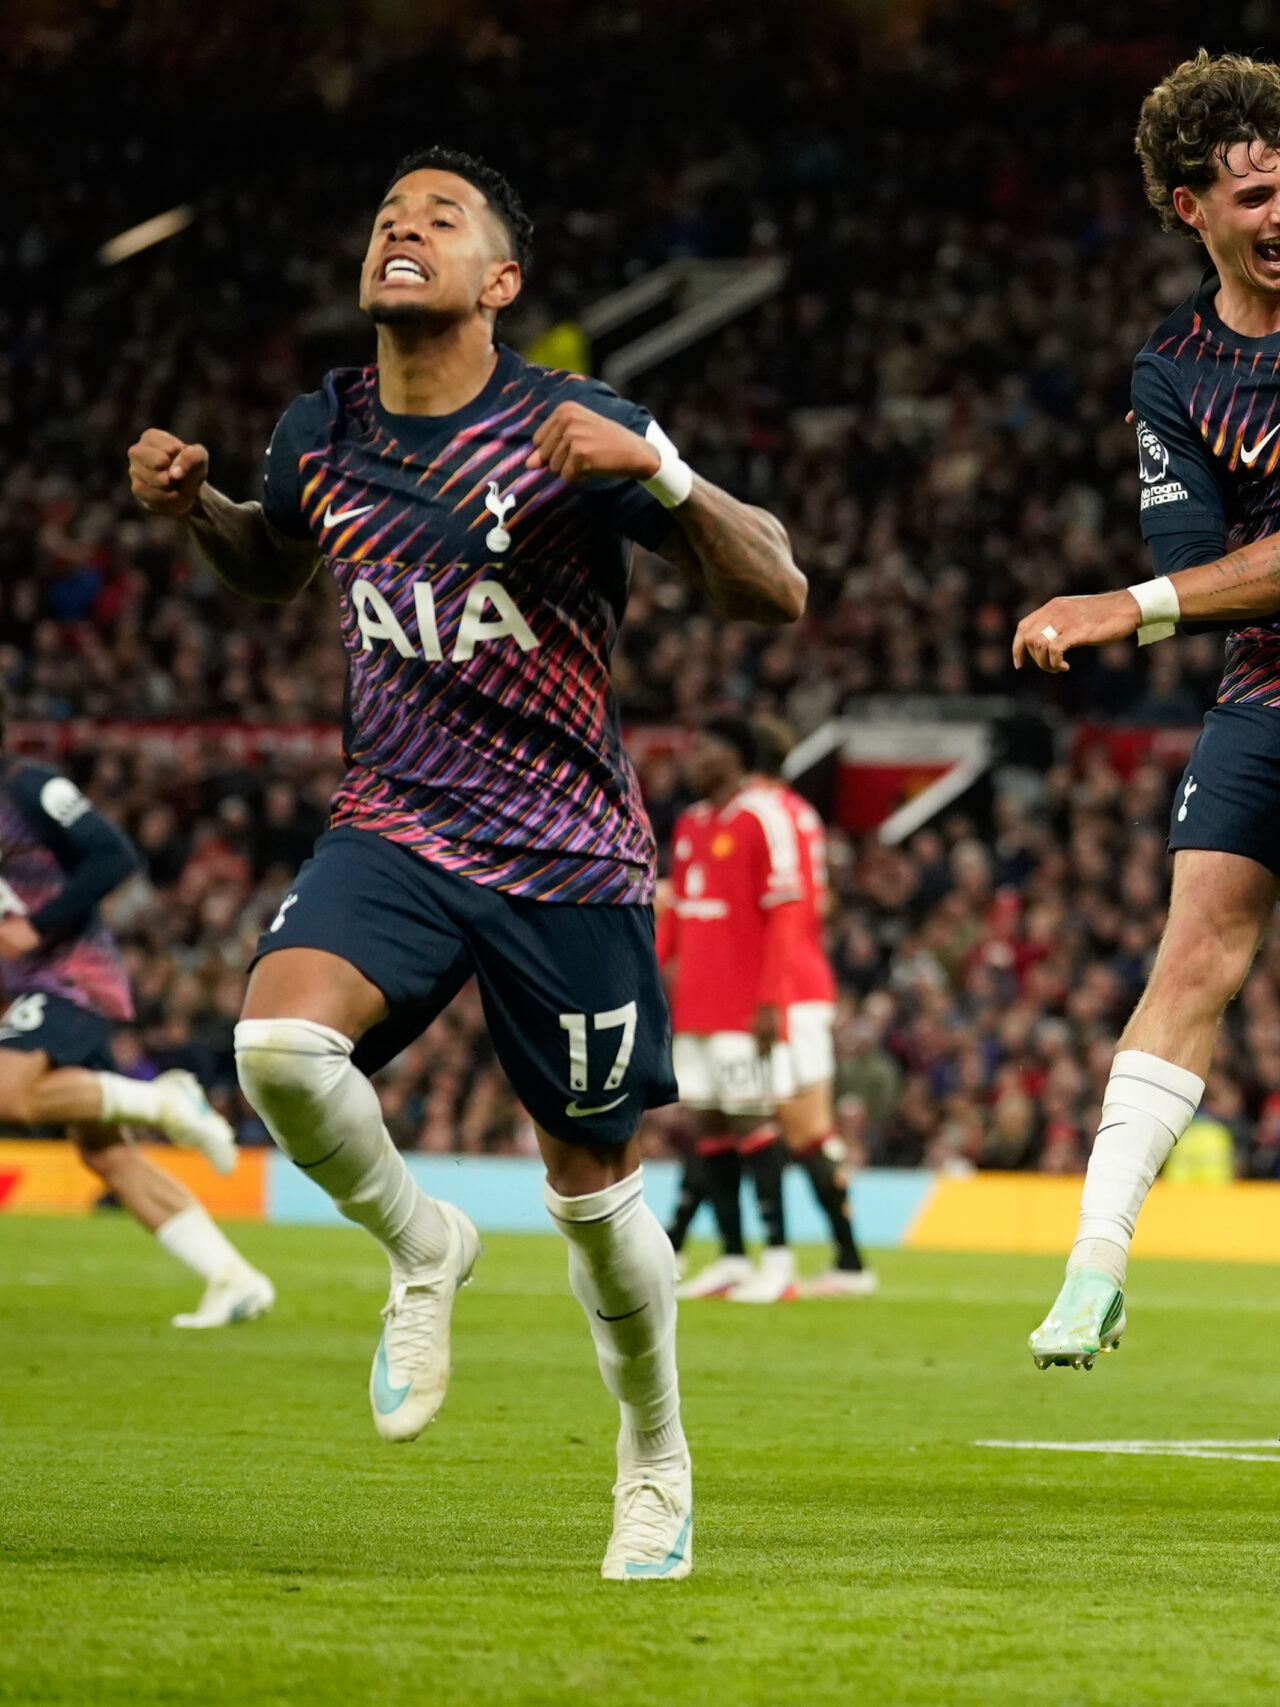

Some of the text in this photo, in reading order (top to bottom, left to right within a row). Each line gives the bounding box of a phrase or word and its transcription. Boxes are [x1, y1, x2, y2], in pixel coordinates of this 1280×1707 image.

[1151, 482, 1181, 496] room
[1151, 490, 1188, 505] racism
[351, 580, 540, 662] AIA
[559, 1000, 638, 1091] 17
